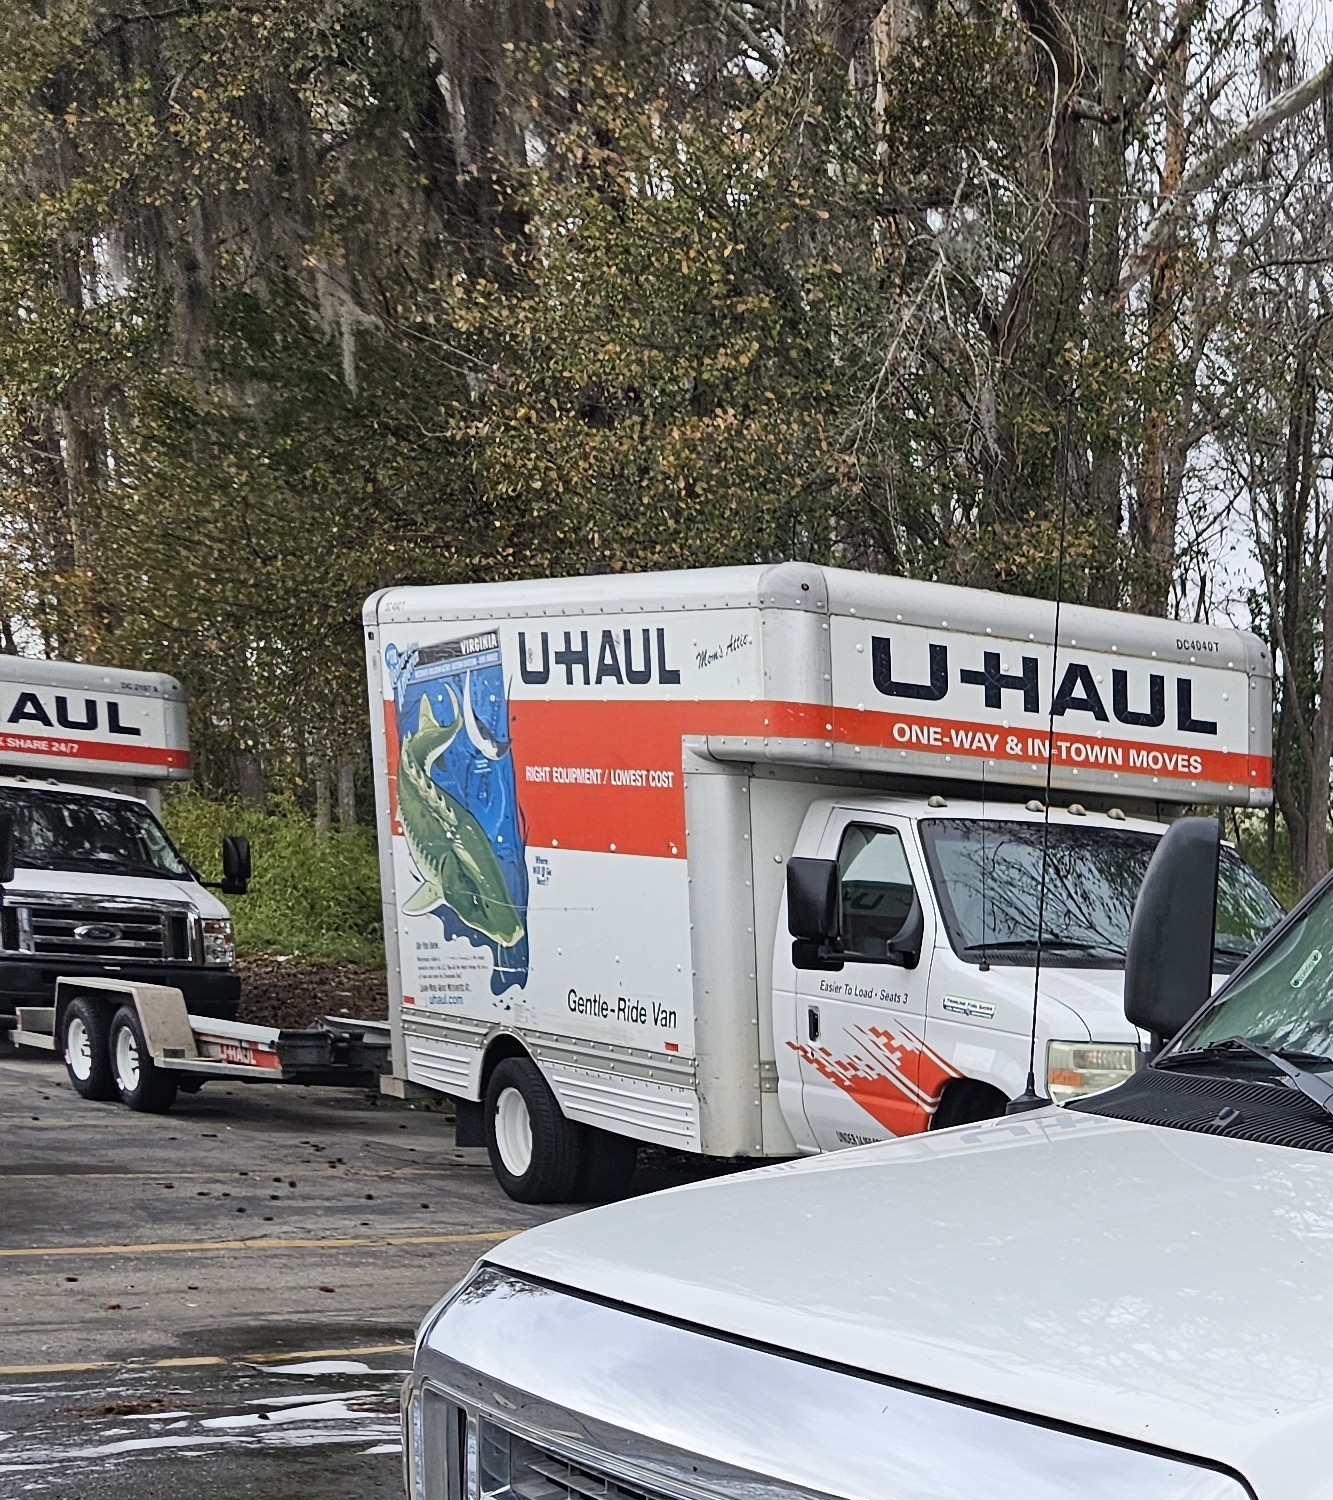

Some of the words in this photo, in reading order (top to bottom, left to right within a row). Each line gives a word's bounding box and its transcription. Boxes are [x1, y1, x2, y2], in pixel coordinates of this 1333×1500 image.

[460, 633, 498, 655] VIRGINIA
[518, 628, 681, 685] U-HAUL
[696, 646, 724, 670] Mom's
[726, 634, 749, 656] Attic
[1176, 638, 1220, 653] DC4040T
[871, 636, 1217, 735] U-HAUL
[6, 737, 49, 751] SHARE
[51, 741, 79, 753] 24/7
[892, 722, 999, 752] ONE-WAY
[1005, 735, 1023, 755] &
[1027, 737, 1123, 766] IN-TOWN
[1129, 748, 1203, 774] MOVES
[525, 766, 551, 783] RIGHT
[552, 767, 602, 785] EQUIPMENT
[611, 769, 647, 786] LOWEST
[649, 770, 674, 788] COST
[819, 979, 843, 994] Easier
[844, 983, 853, 996] To
[854, 985, 874, 999] Load
[880, 989, 902, 1004] Seats
[902, 993, 909, 1004] 3
[567, 988, 647, 1025] Gentle-Ride
[652, 1001, 677, 1029] Van
